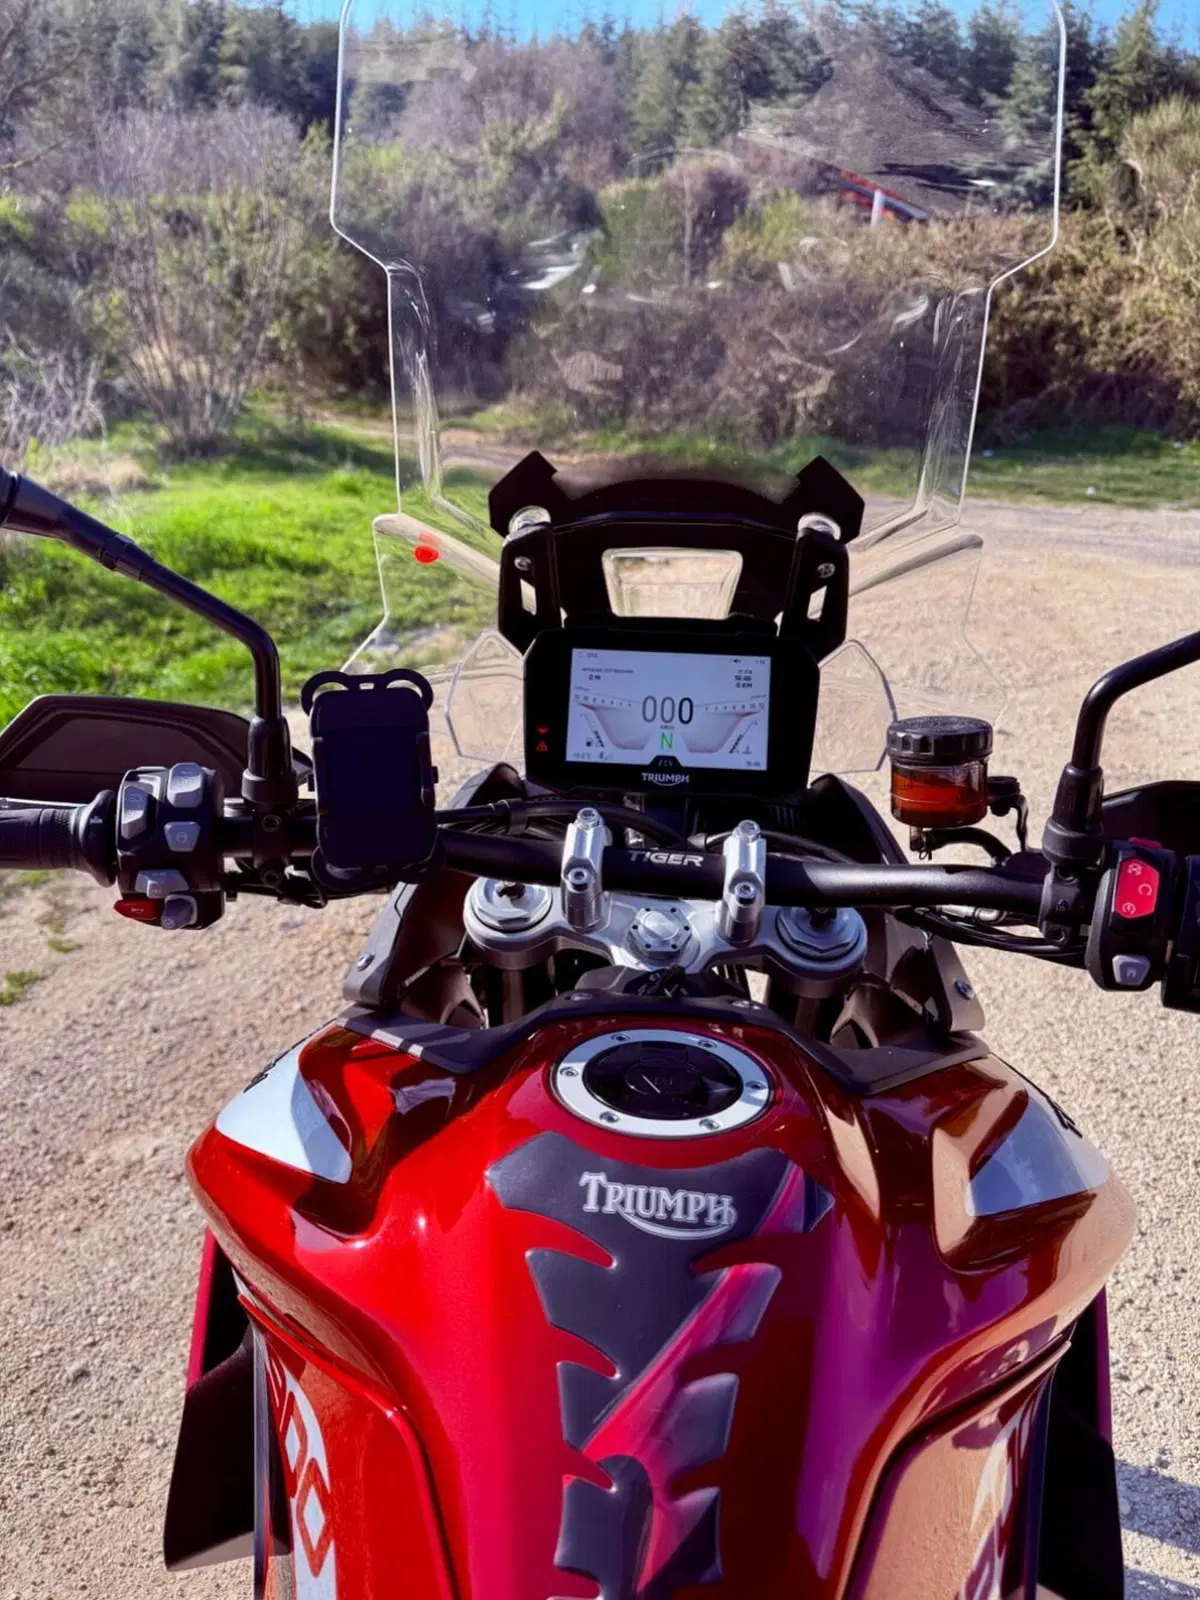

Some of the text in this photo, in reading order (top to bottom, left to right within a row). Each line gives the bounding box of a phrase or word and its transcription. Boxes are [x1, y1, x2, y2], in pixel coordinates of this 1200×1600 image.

[642, 695, 694, 724] 000
[660, 732, 673, 750] N
[641, 772, 690, 786] TRIUMPH
[628, 850, 704, 867] TIGER
